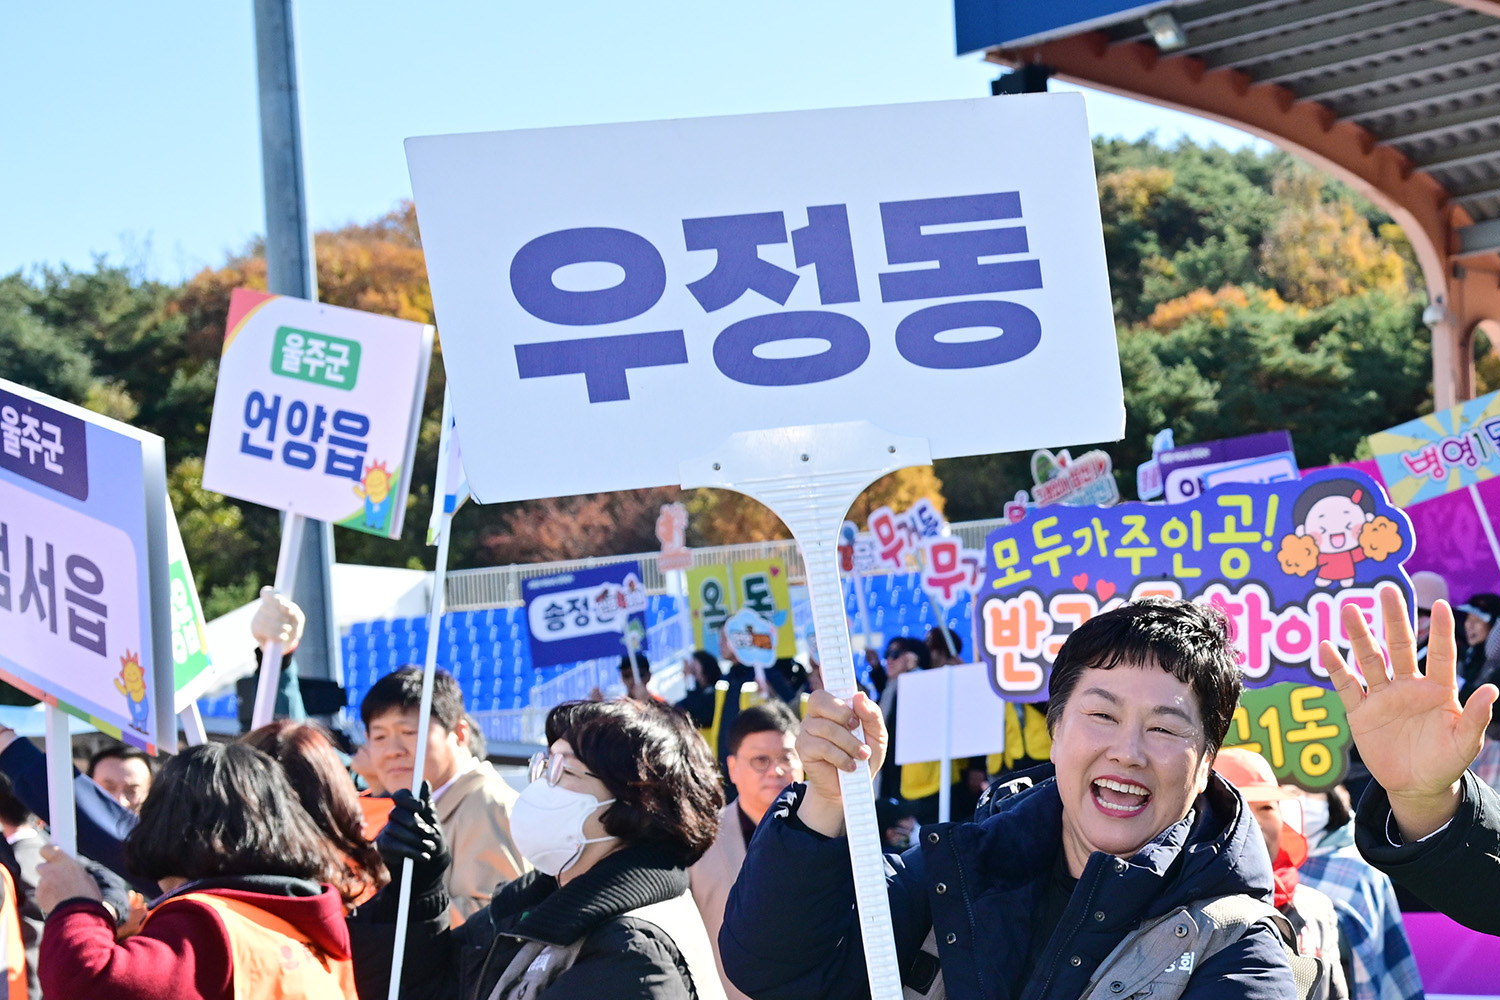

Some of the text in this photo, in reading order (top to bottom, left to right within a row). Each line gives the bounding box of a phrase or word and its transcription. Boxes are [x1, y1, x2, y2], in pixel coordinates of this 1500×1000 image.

[509, 190, 1044, 404] 우정동
[281, 332, 350, 384] 울주군
[0, 405, 65, 475] 울주군
[240, 390, 370, 482] 언양읍
[992, 493, 1280, 590] 모두가 주인공!
[0, 520, 108, 659] 서읍
